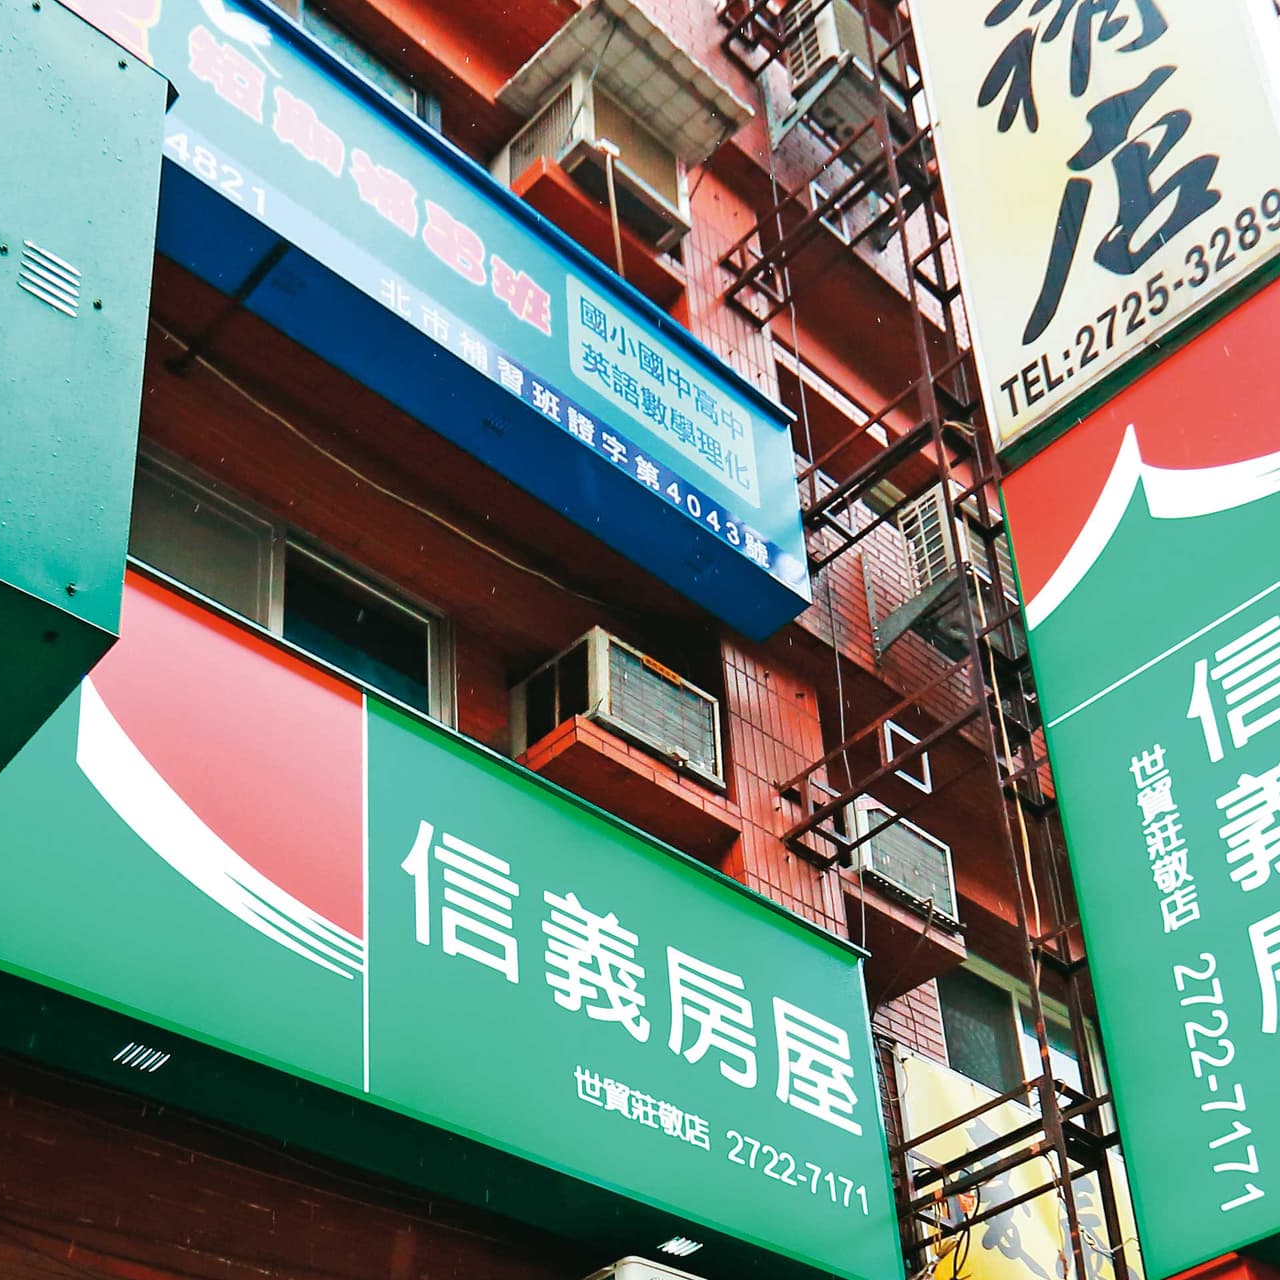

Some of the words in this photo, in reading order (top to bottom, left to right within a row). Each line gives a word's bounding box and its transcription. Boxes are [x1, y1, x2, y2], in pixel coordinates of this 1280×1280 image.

[380, 278, 772, 570] 北市補習班證字第4043號
[578, 294, 747, 443] 國小國中高中
[581, 341, 753, 492] 英語數學理化
[400, 819, 863, 1137] 信義房屋
[1128, 743, 1201, 934] 世貿莊敬店
[1172, 951, 1266, 1213] 2722-7171
[573, 1065, 712, 1151] 世貿莊敬店
[726, 1129, 869, 1216] 2722-7171
